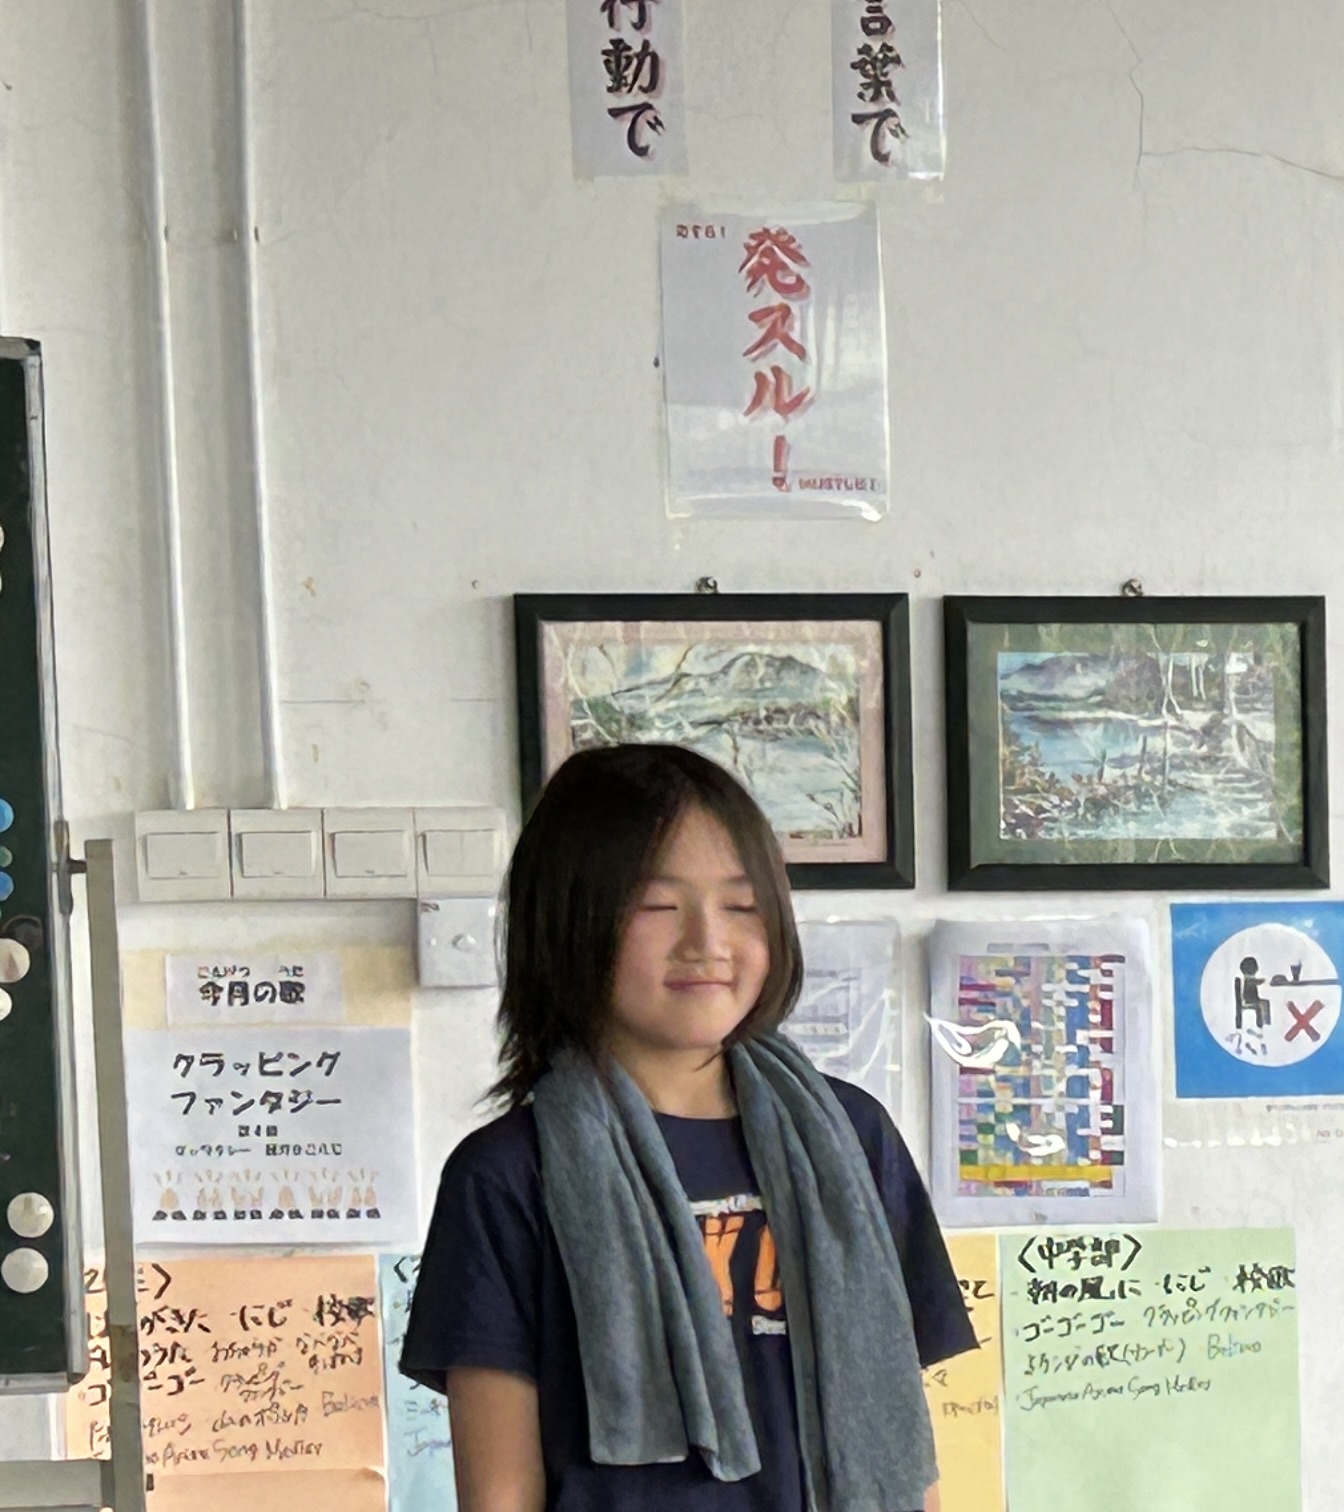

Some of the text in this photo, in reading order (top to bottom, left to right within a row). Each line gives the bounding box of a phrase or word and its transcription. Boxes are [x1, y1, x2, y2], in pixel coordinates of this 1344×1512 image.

[173, 1051, 341, 1078] クラッピング
[171, 1089, 342, 1116] ファンタジー
